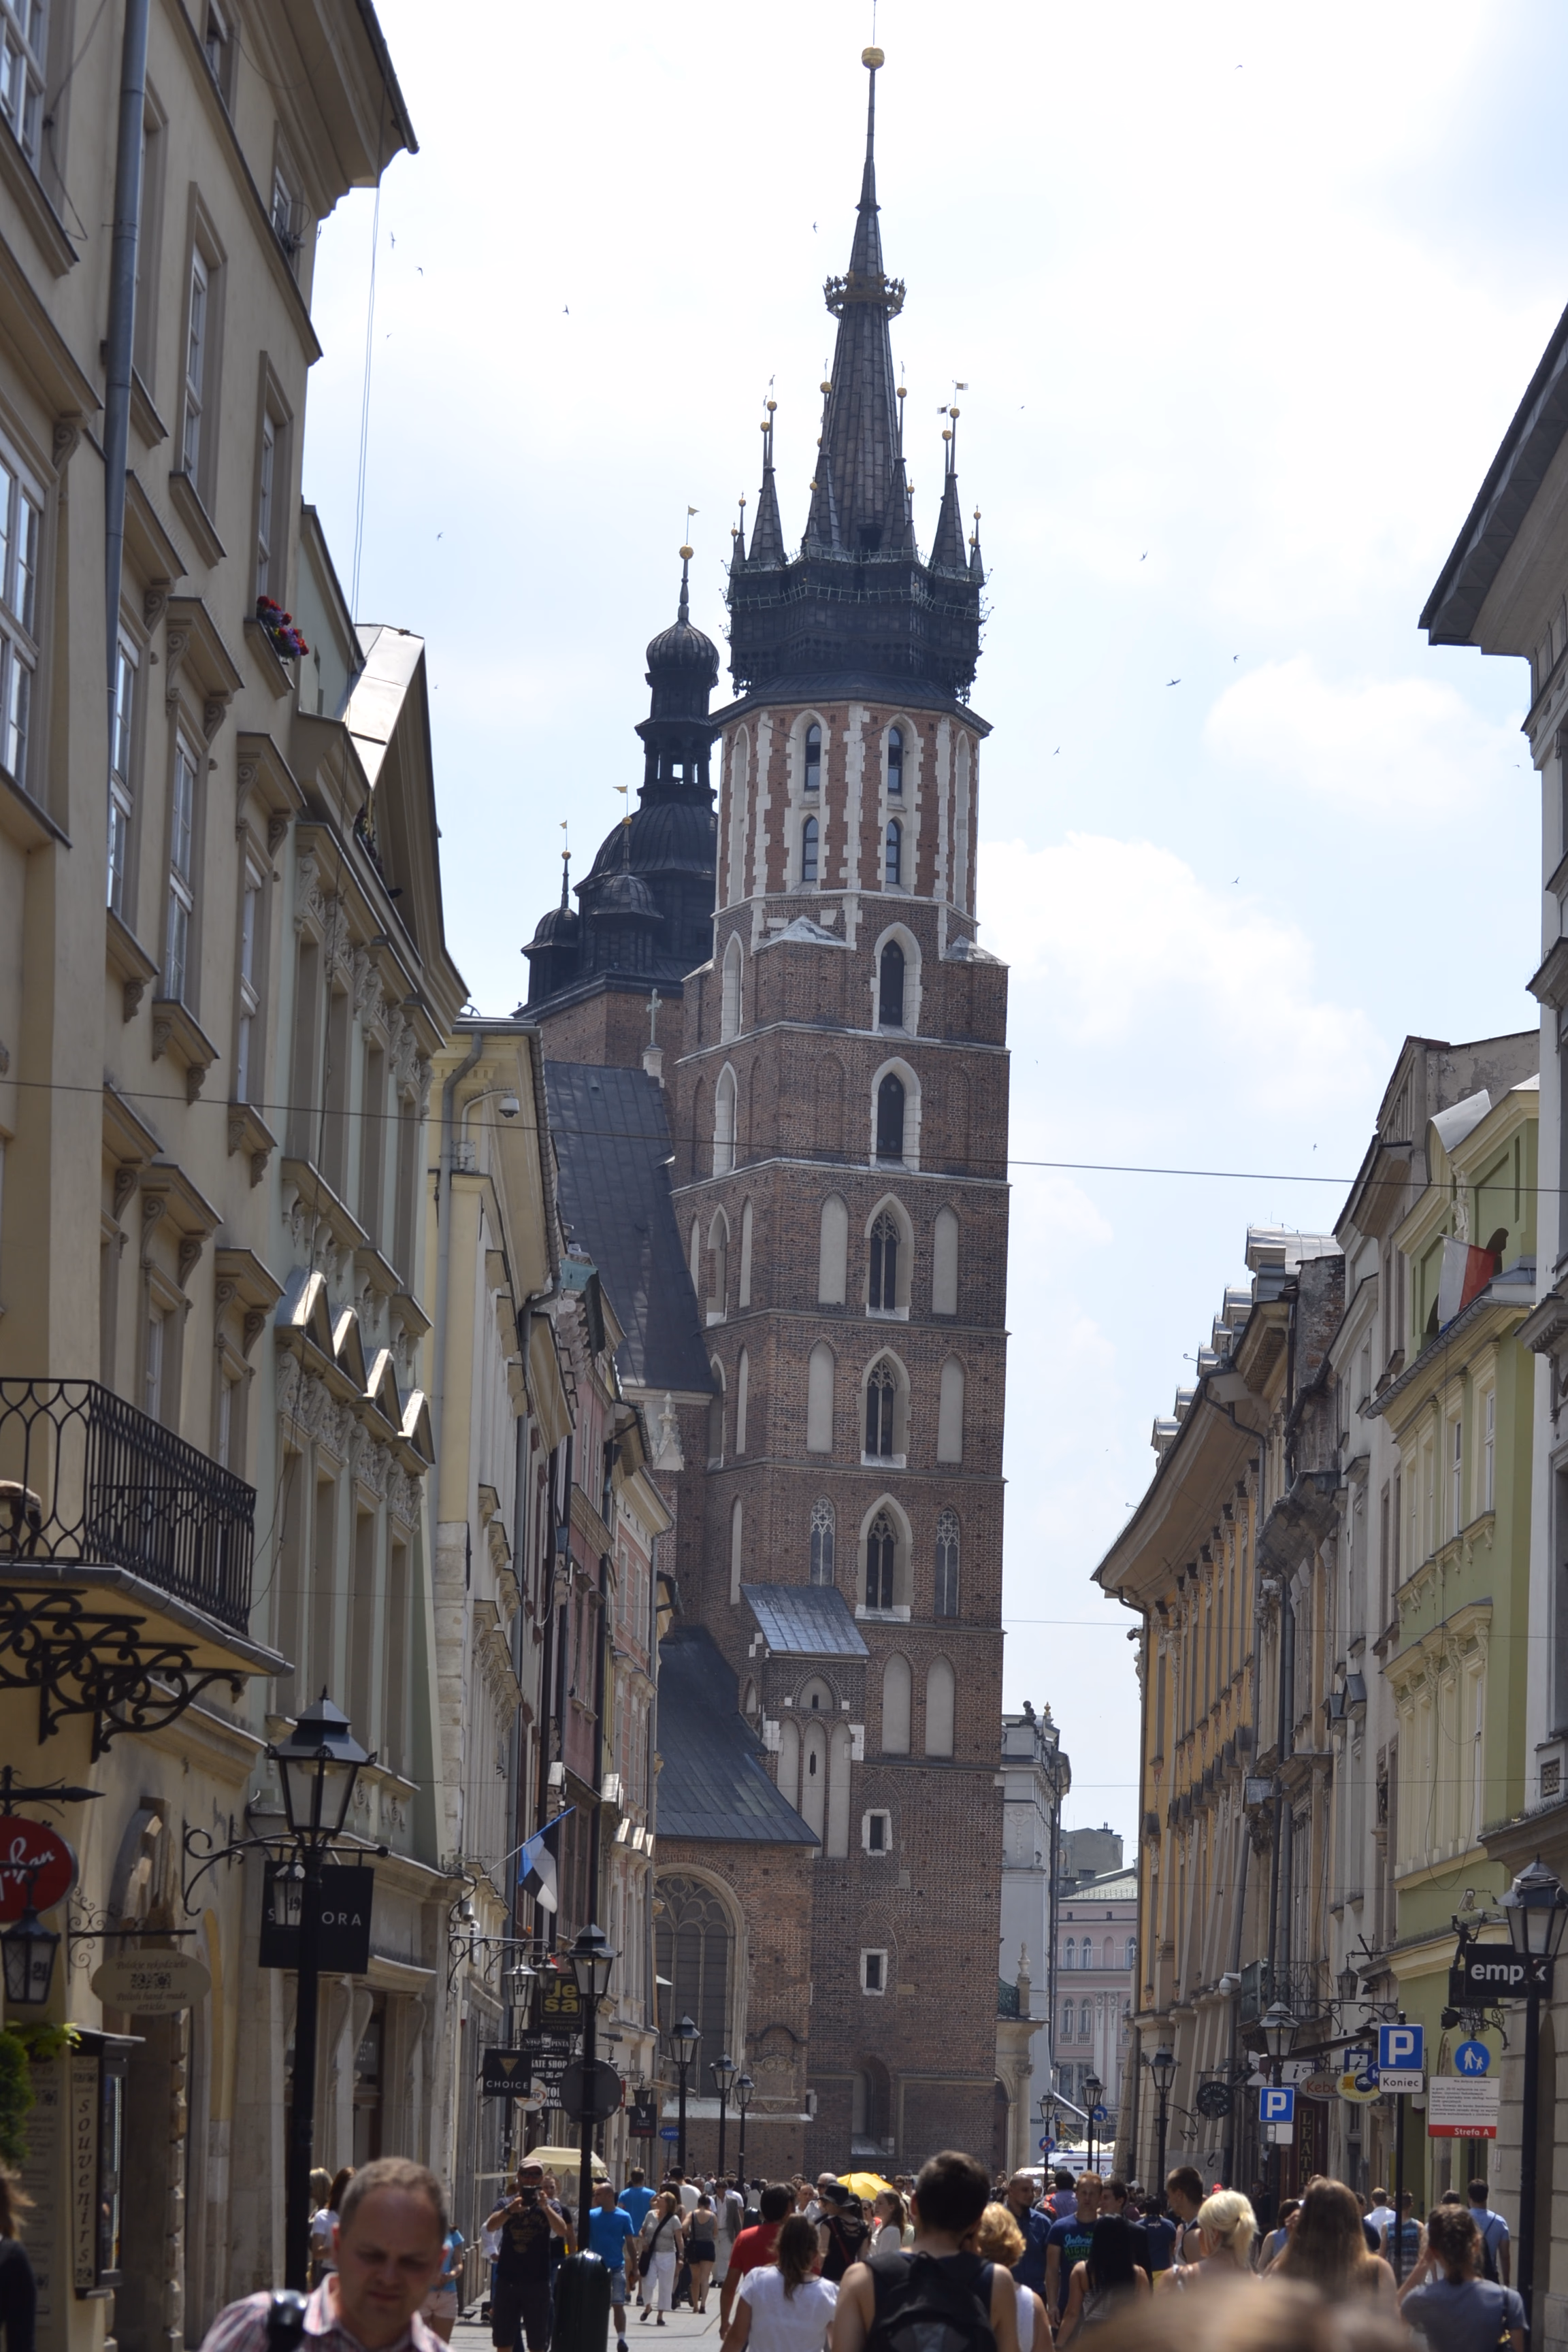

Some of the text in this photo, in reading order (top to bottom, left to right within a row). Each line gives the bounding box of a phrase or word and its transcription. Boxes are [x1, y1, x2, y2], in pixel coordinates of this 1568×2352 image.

[288, 1896, 301, 1911] 19
[32, 1961, 48, 1980] 21
[1471, 1964, 1546, 1984] empk
[515, 1984, 526, 1995] 17
[545, 1999, 578, 2012] sa
[1388, 2030, 1414, 2065] P
[549, 2060, 568, 2069] SHOP
[486, 2080, 529, 2089] CHOICE
[1383, 2077, 1419, 2087] Koniec
[1267, 2091, 1287, 2118] P
[1454, 2127, 1480, 2136] Strefa
[1300, 2112, 1312, 2183] LEATH
[78, 2099, 93, 2263] souvenirs
